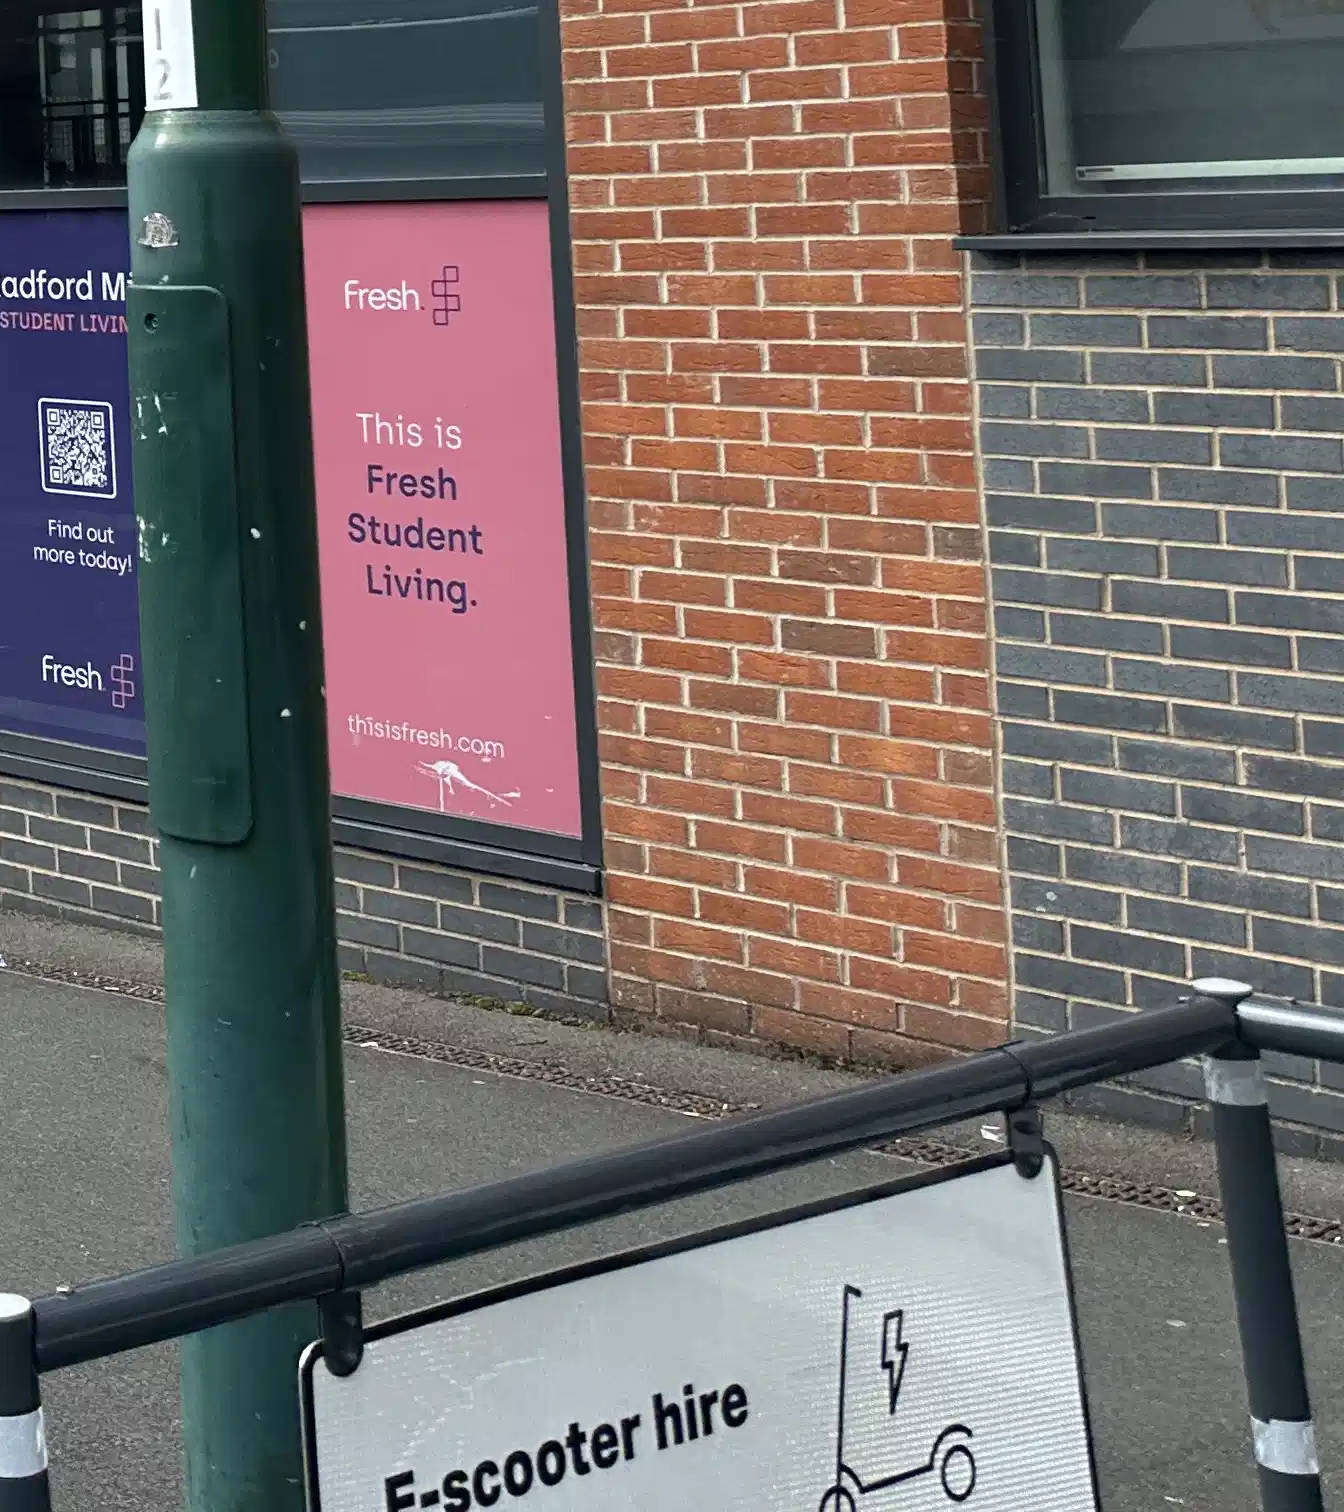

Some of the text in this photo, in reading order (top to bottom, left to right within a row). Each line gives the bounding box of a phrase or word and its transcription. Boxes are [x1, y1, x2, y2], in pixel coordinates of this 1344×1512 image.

[0, 311, 75, 332] STUDENT
[355, 412, 463, 451] This is
[365, 464, 457, 501] Fresh
[48, 519, 115, 544] Find out
[346, 512, 484, 555] Student
[33, 546, 133, 576] more today!
[365, 564, 478, 614] Living.
[347, 714, 505, 759] thisisfresh.com
[384, 1383, 749, 1512] E-scooter hire
